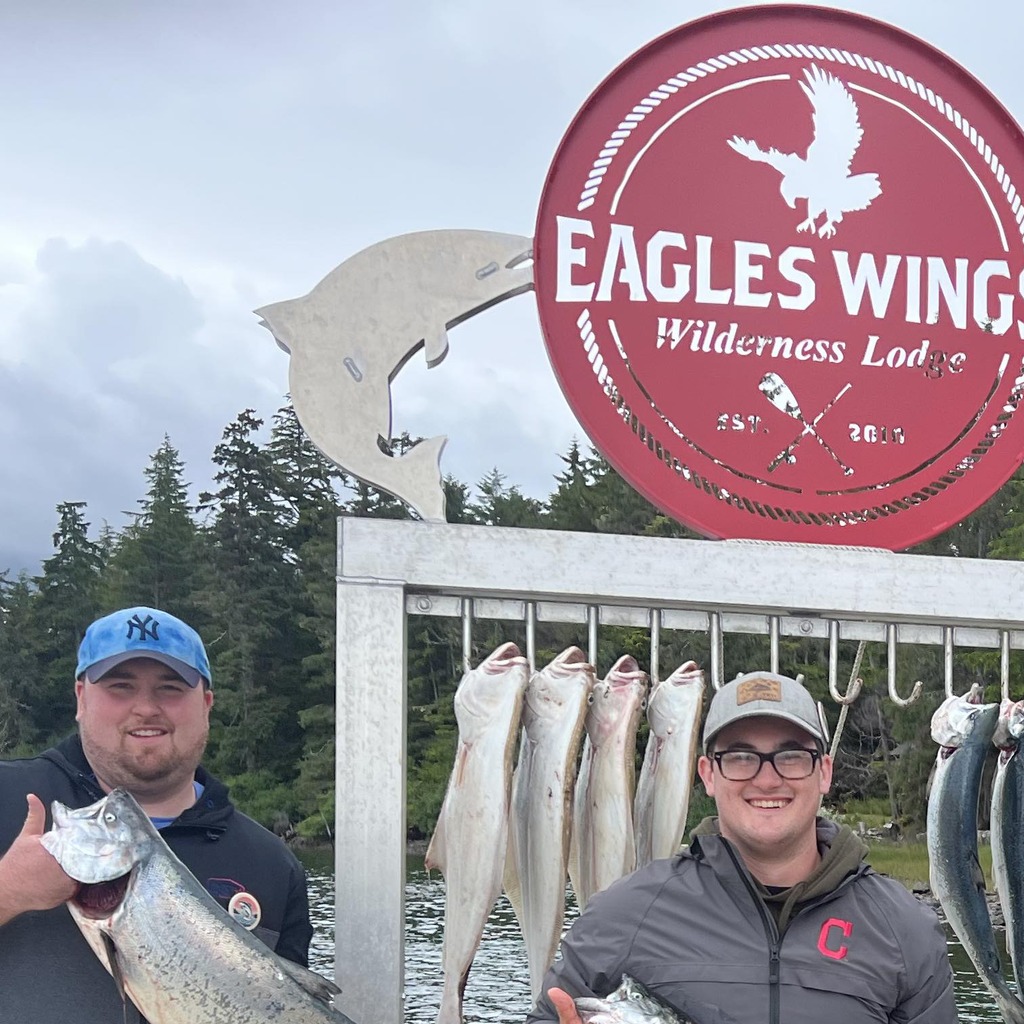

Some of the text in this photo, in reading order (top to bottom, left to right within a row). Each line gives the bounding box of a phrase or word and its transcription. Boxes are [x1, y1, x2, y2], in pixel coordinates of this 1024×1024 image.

[555, 214, 817, 311] EAGLES
[655, 316, 967, 380] Wilderness Lodge
[126, 614, 160, 641] NY
[817, 917, 853, 960] C
